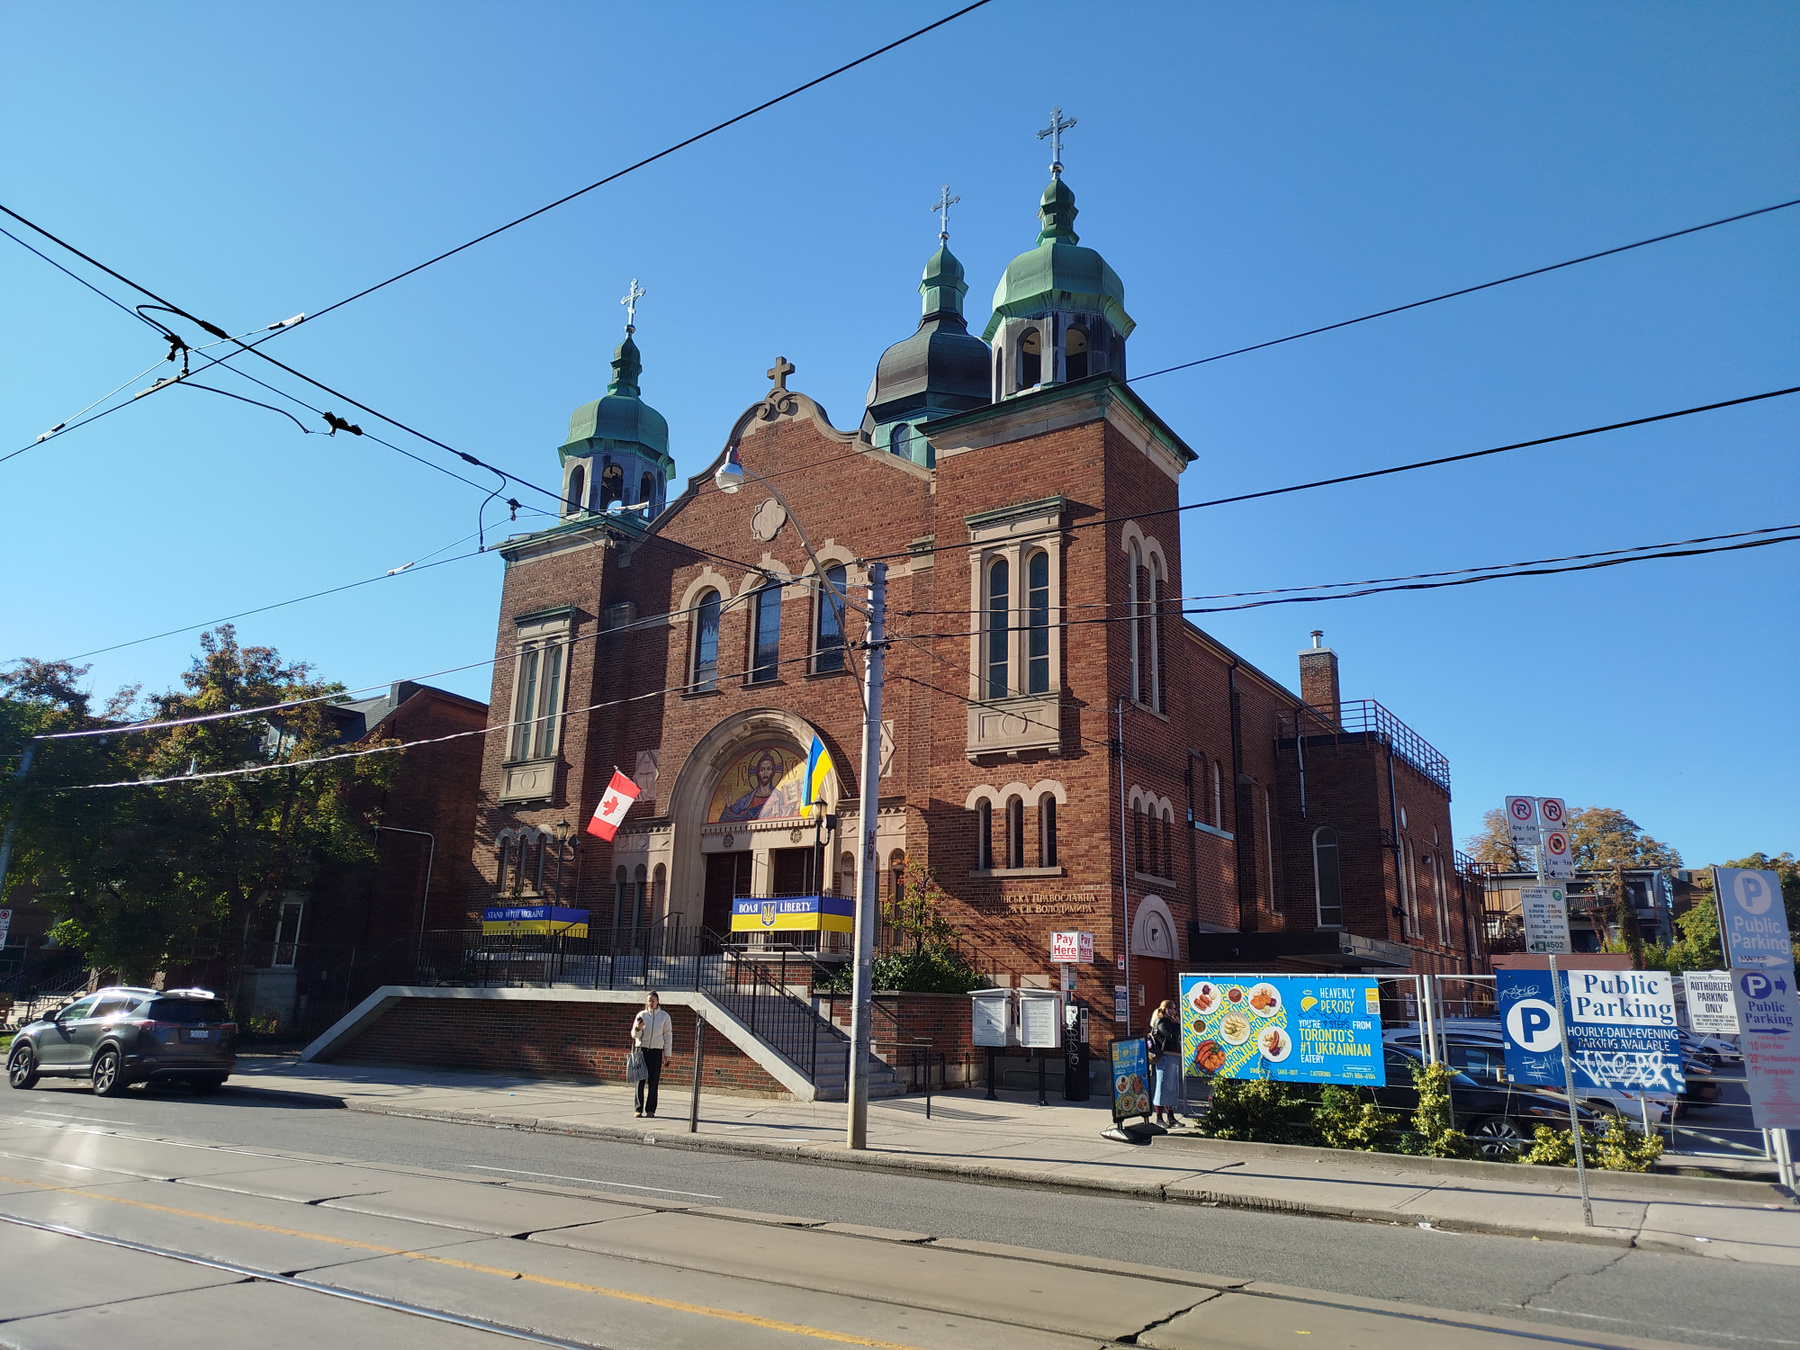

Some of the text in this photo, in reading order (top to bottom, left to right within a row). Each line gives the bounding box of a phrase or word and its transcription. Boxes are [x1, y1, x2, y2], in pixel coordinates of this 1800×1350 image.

[738, 902, 758, 914] ВОЛЯ
[780, 901, 812, 912] LIBERTY
[487, 909, 544, 919] STAND WITH UKRAINE
[1733, 915, 1782, 934] Public
[1056, 934, 1074, 946] Pay
[1081, 934, 1090, 947] Pay
[1545, 941, 1564, 949] 4502
[1731, 933, 1790, 954] Parking
[1054, 945, 1077, 955] Here
[1080, 945, 1092, 955] Here
[1583, 974, 1659, 995] Public
[1691, 982, 1732, 991] AUTHORIZED
[1320, 988, 1356, 999] HEAVENLY
[1697, 992, 1729, 1002] PARKING
[1320, 1000, 1355, 1014] PEROGY
[1576, 997, 1674, 1025] Parking
[1705, 1003, 1723, 1013] ONLY
[1748, 1001, 1786, 1012] Public
[1299, 1019, 1321, 1028] YOU'RE
[1329, 1020, 1350, 1029] STEPS
[1352, 1021, 1371, 1030] FROM
[1521, 1007, 1550, 1043] P
[1745, 1013, 1794, 1027] Parking
[1299, 1028, 1355, 1043] TORONTO'S
[1300, 1041, 1371, 1057] #1 UKRAINIAN
[1578, 1037, 1671, 1051] PARKING AVAILABLE
[1300, 1054, 1325, 1064] EATERY
